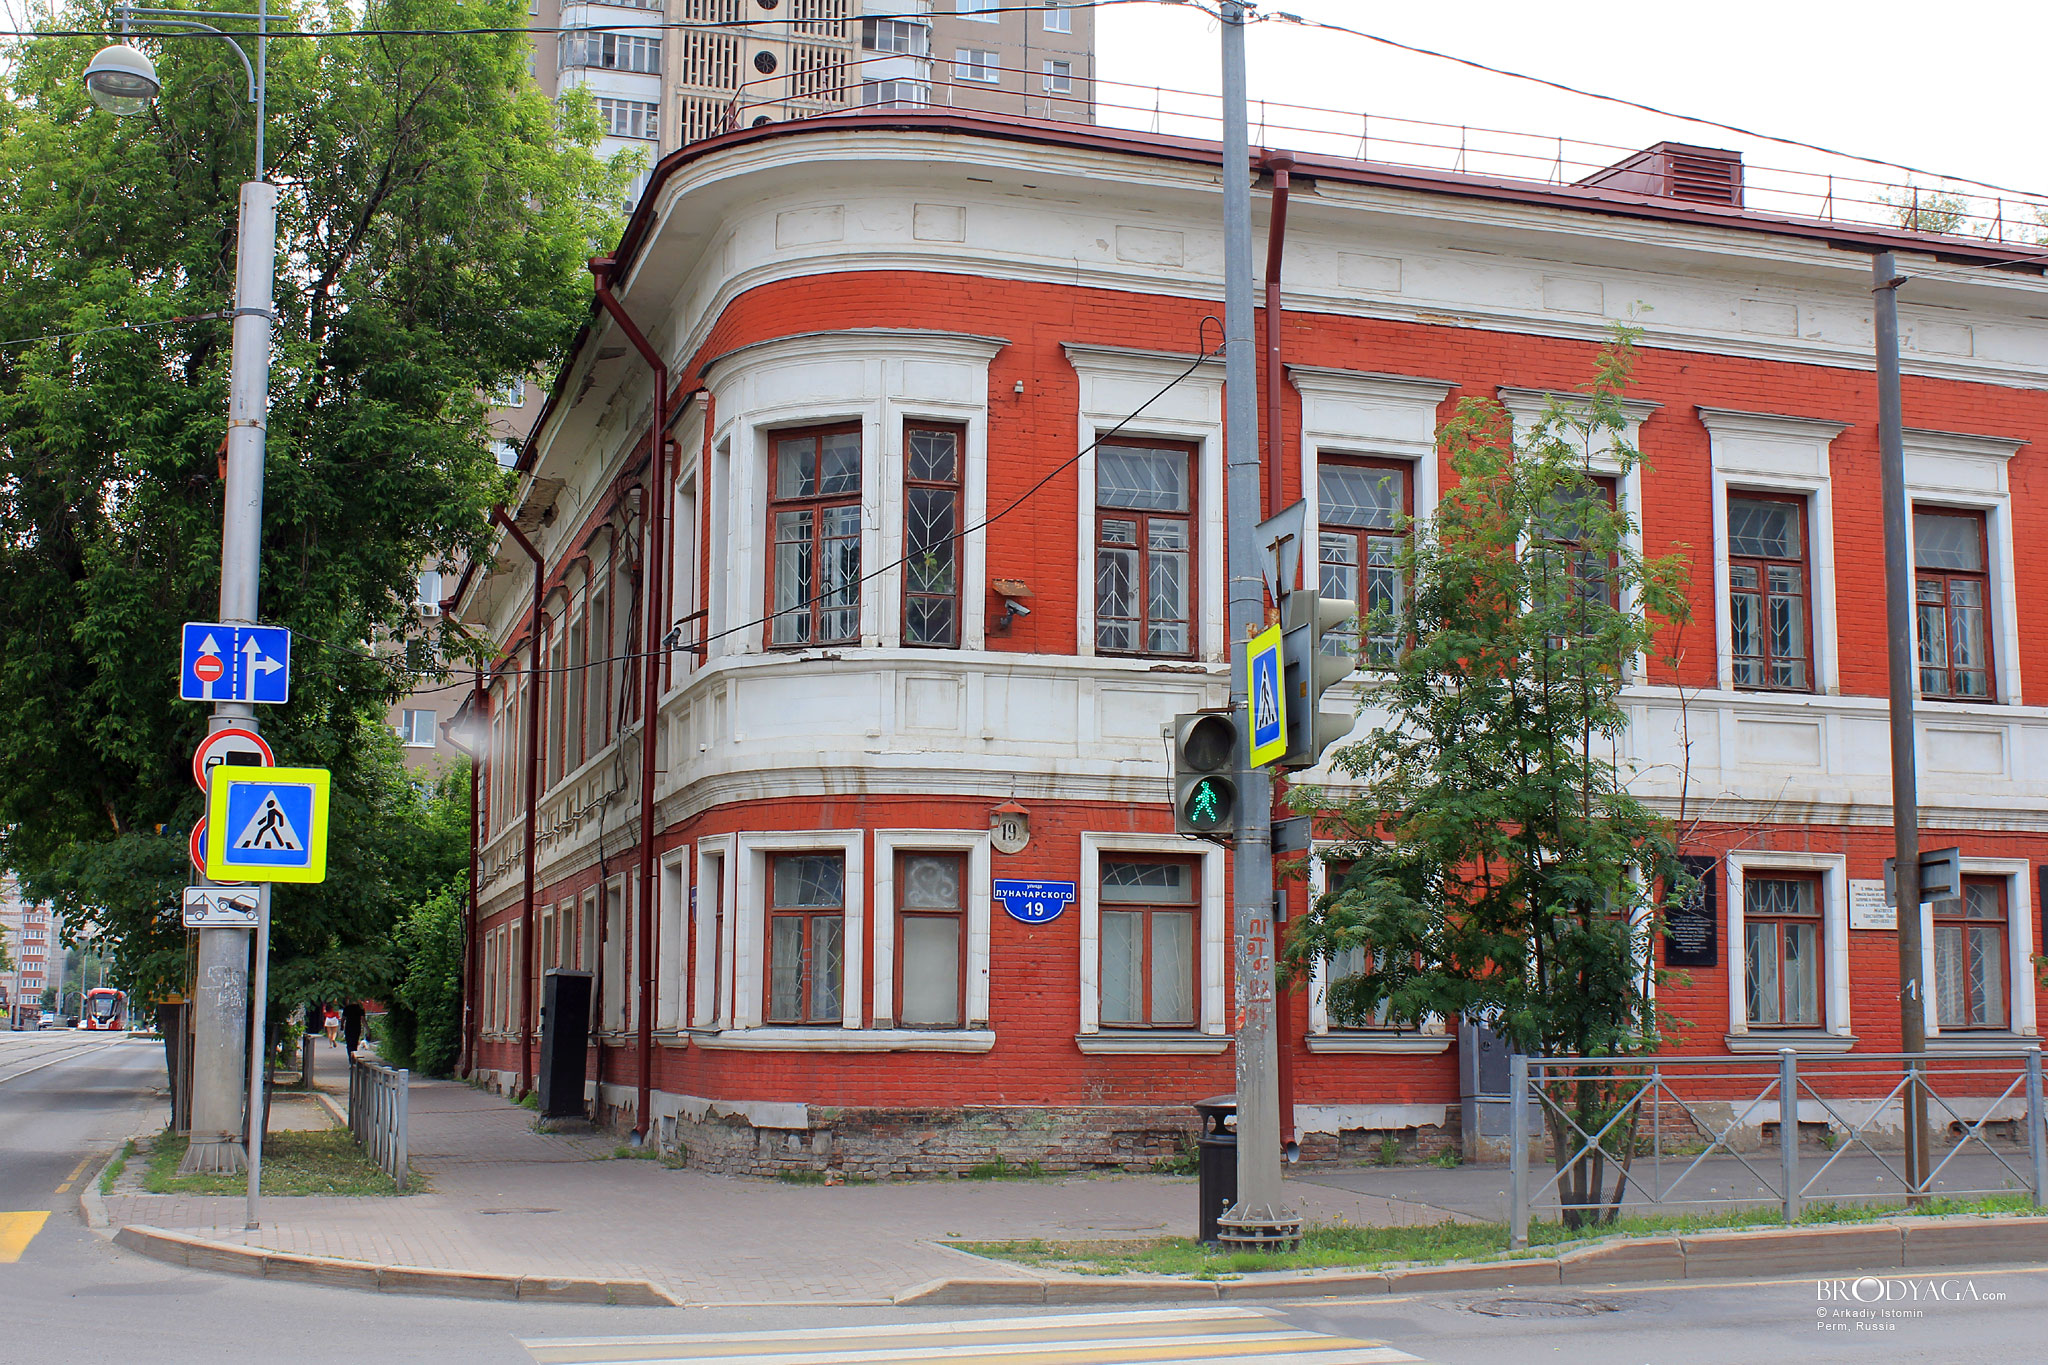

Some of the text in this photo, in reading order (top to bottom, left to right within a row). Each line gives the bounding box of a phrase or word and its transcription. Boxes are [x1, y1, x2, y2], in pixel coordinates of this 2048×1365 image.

[1002, 823, 1017, 841] 19
[995, 889, 1073, 900] ЛУНАЧАРСКОГО
[1025, 901, 1044, 917] 19
